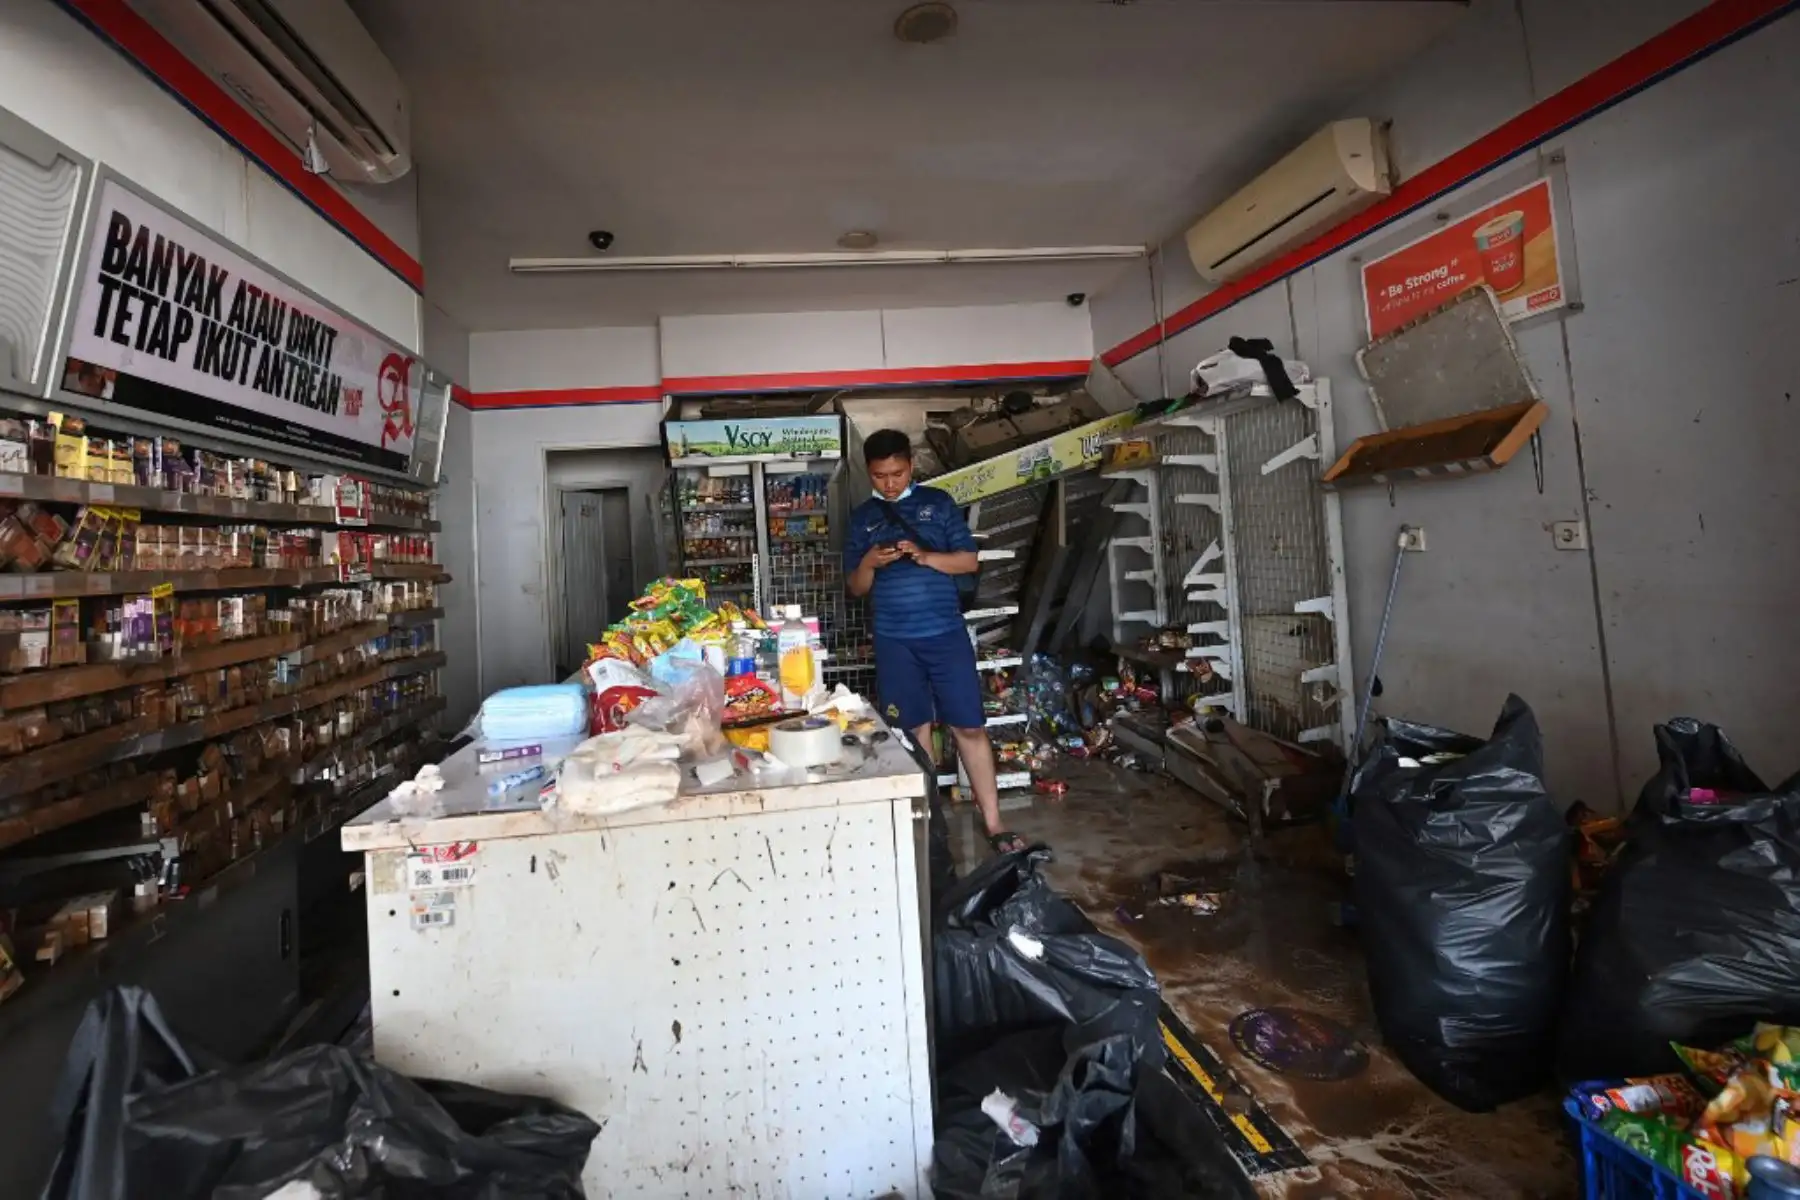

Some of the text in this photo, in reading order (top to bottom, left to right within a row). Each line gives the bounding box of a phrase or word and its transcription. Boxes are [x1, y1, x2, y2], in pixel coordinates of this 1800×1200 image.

[94, 271, 194, 363] TETAP
[192, 317, 258, 386] IKUT
[252, 344, 342, 416] ANTREAN
[101, 209, 339, 371] BANYAK ATAU DIKIT
